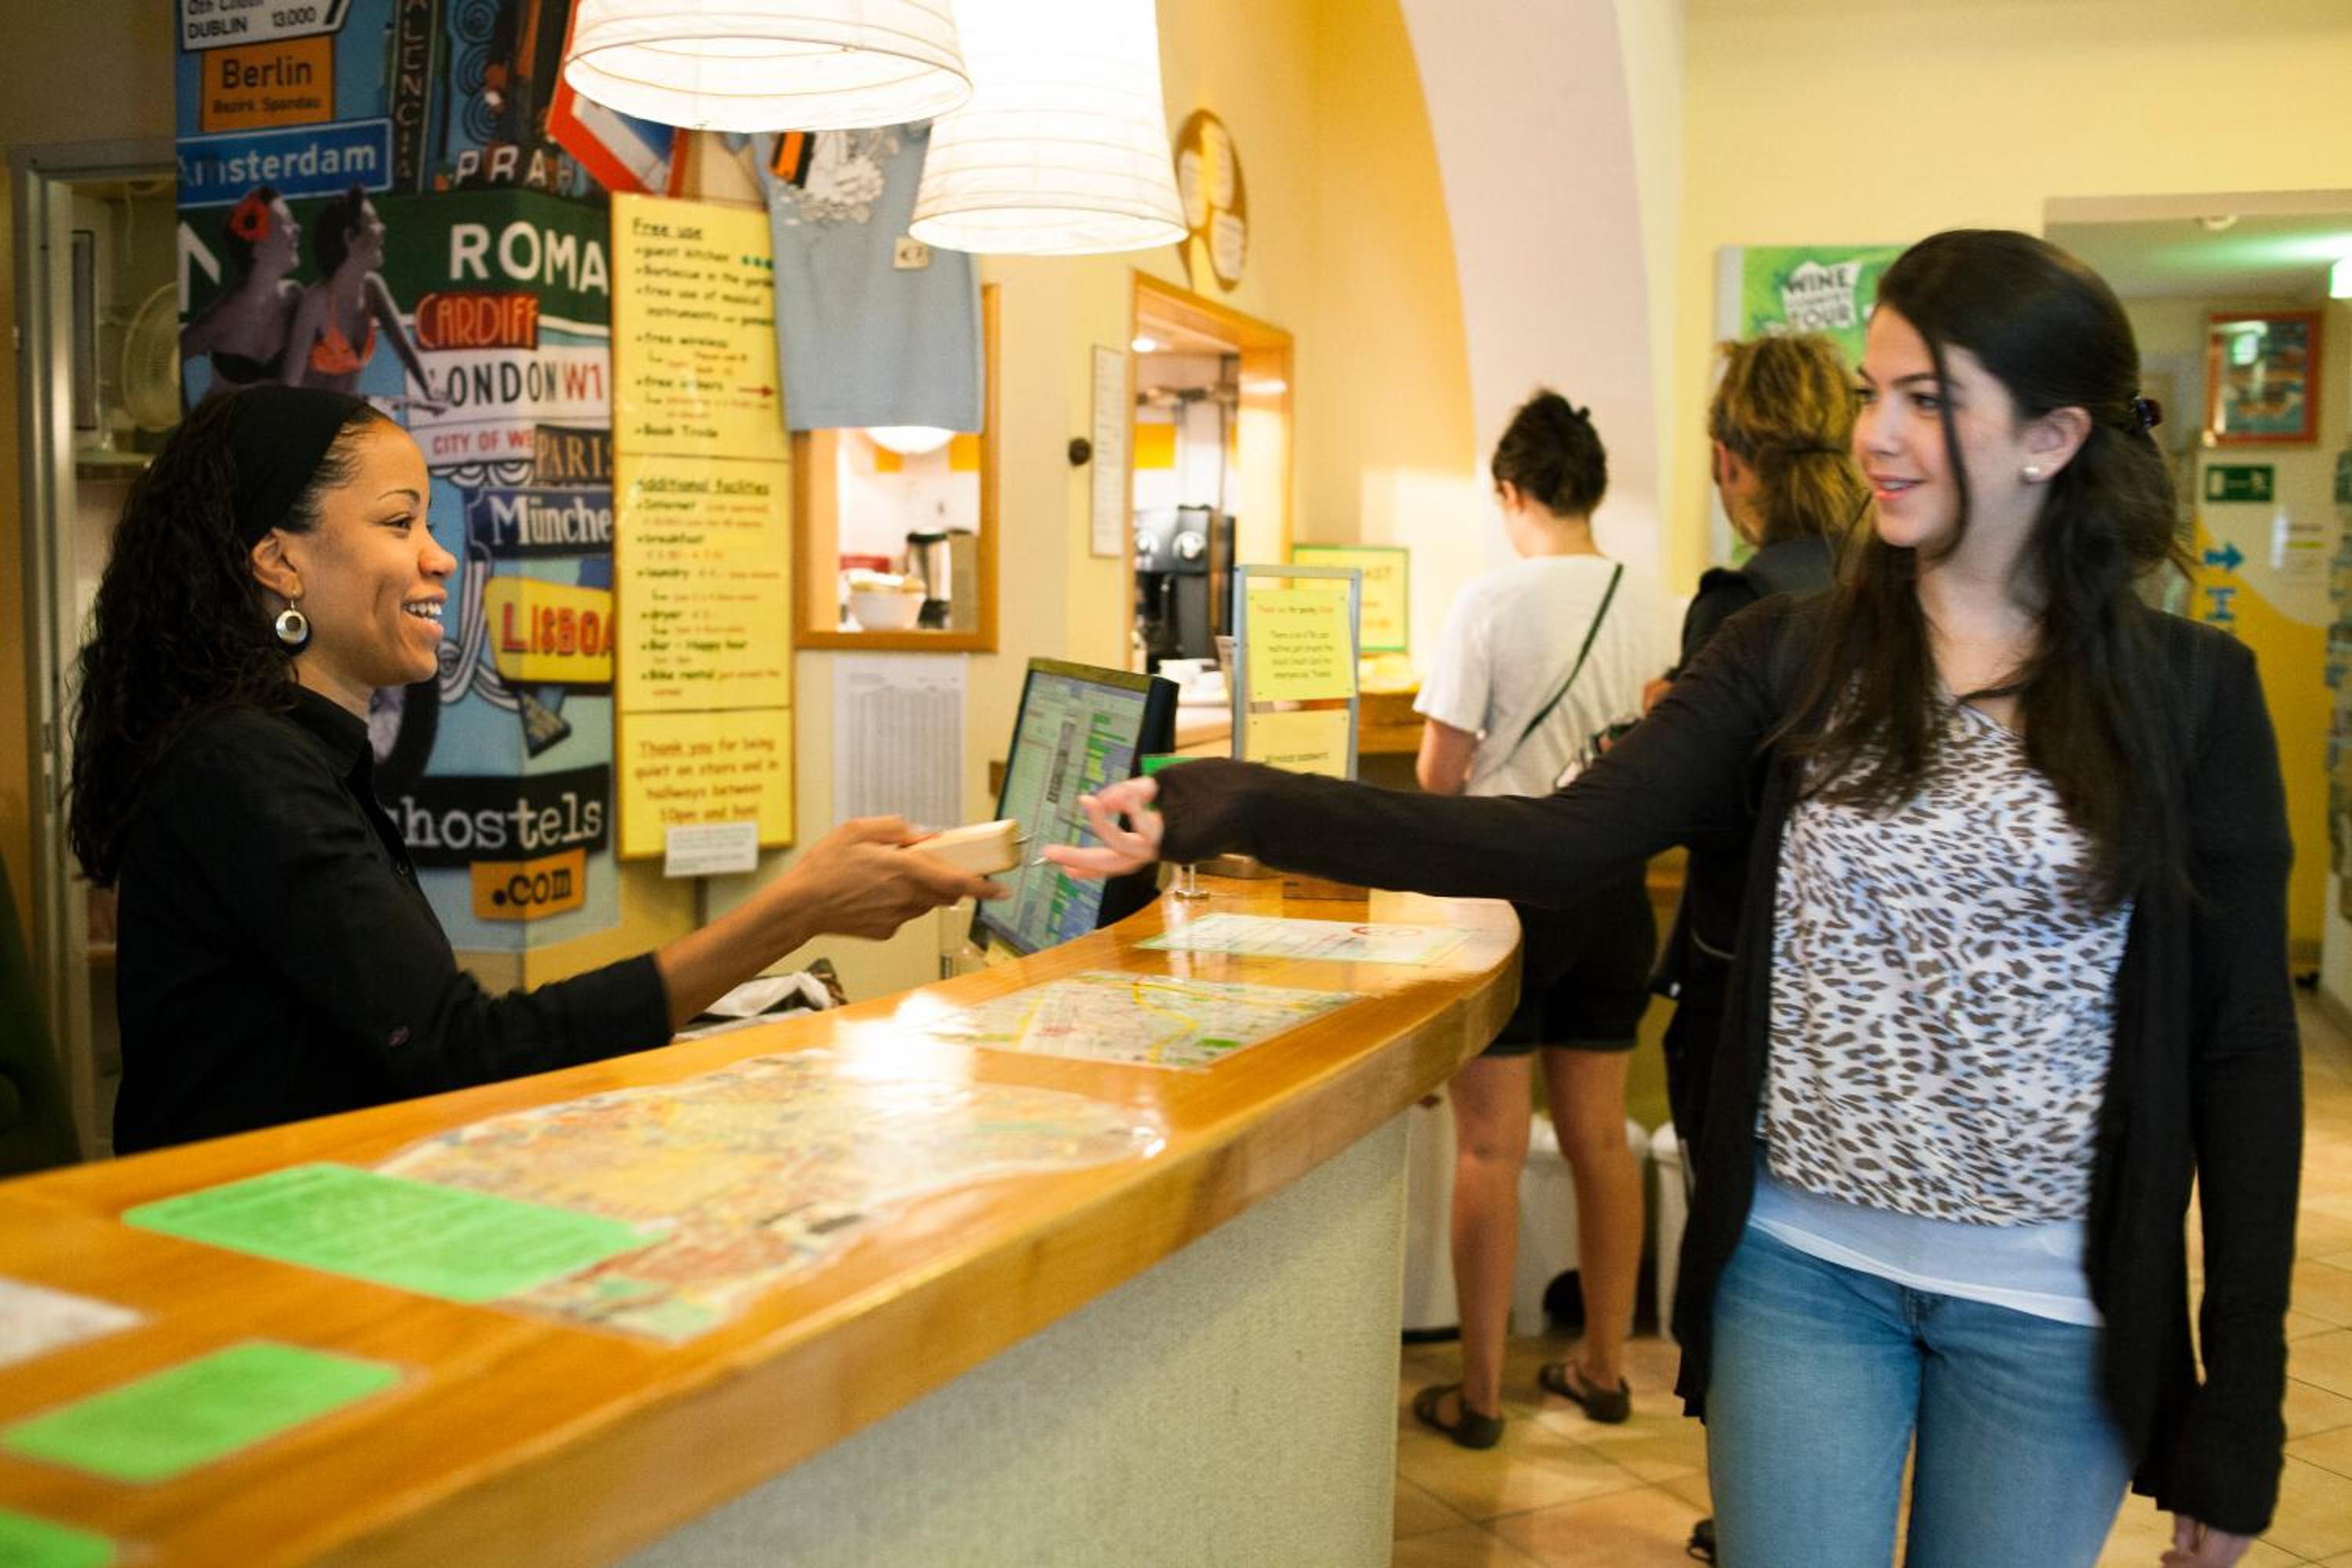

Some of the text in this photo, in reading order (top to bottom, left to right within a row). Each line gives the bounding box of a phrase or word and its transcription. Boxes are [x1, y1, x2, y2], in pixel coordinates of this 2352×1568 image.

[187, 16, 248, 38] DUBLIN
[222, 56, 312, 89] Berlin
[262, 96, 320, 112] Spandau
[633, 217, 702, 239] Free use
[449, 220, 609, 296] ROMA
[1787, 267, 1849, 293] WINE
[416, 293, 539, 349] CARDIFF
[430, 361, 557, 407] ONDON
[564, 362, 603, 401] W1
[434, 432, 470, 456] CITY
[477, 430, 499, 452] OF
[535, 435, 613, 478] PARI
[488, 495, 612, 546] Münche
[639, 737, 775, 757] Thank you for being
[634, 764, 670, 782] quiet
[675, 764, 694, 777] on
[699, 760, 737, 775] stairs
[742, 760, 764, 773] and
[646, 782, 764, 803] hallways between
[384, 791, 603, 851] hostels
[703, 806, 728, 821] and
[491, 867, 572, 906] .com
